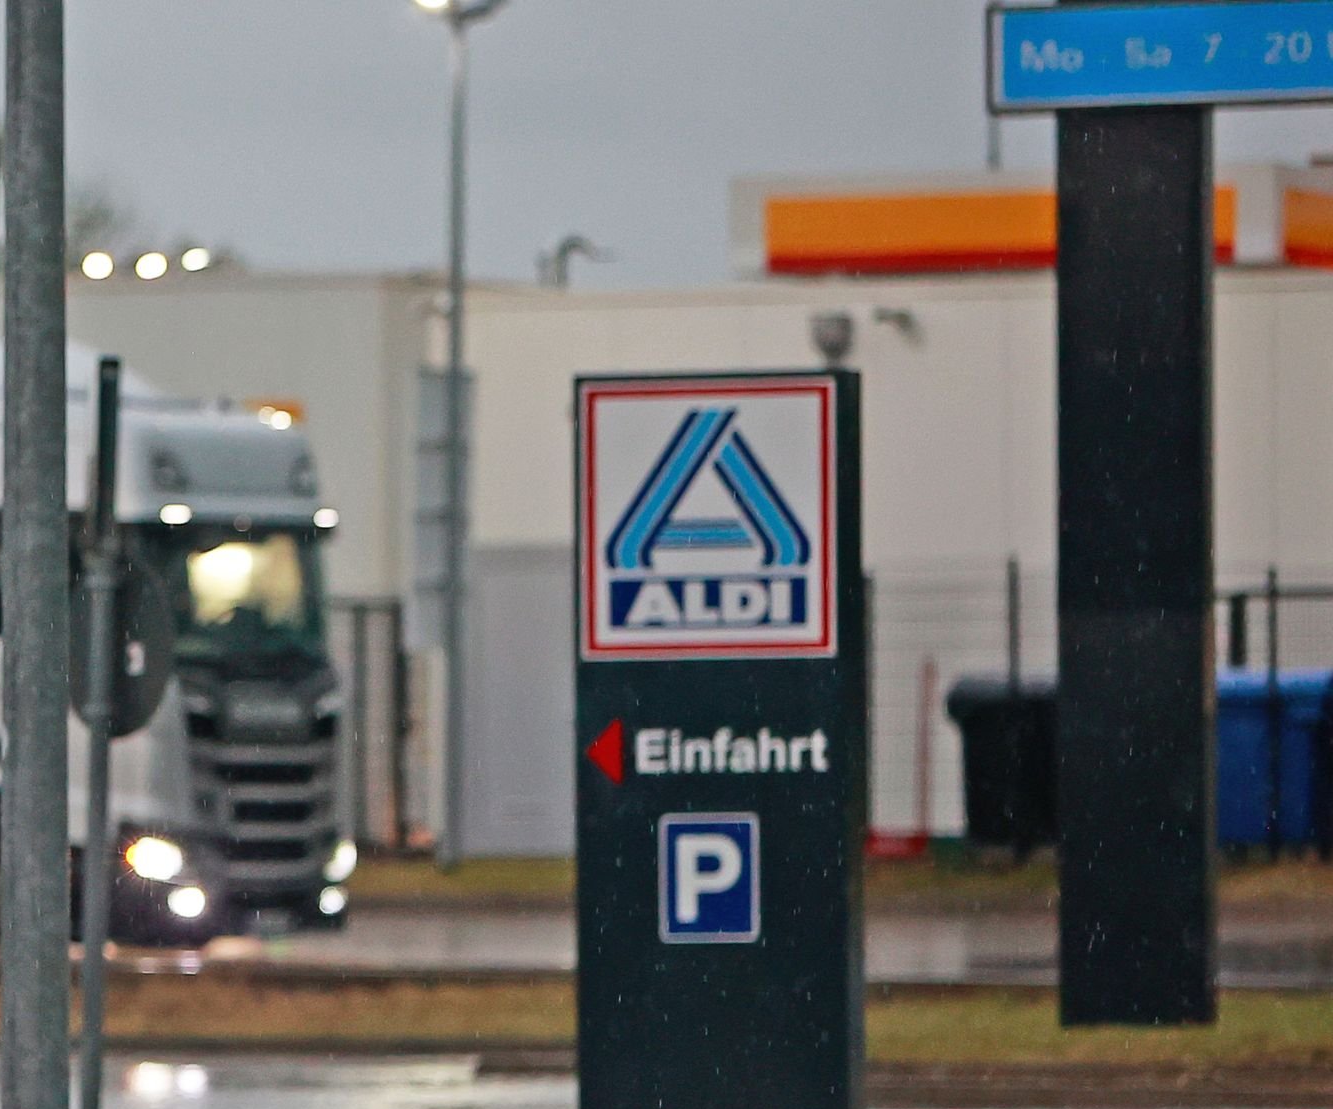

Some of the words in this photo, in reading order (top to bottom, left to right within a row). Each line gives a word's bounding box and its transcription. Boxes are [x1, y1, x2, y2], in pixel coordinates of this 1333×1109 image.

[1019, 39, 1083, 73] Mo
[1202, 32, 1223, 64] 7
[1263, 30, 1313, 64] 20
[625, 581, 792, 626] ALDI
[635, 726, 829, 775] Einfahrt
[675, 833, 743, 925] P
